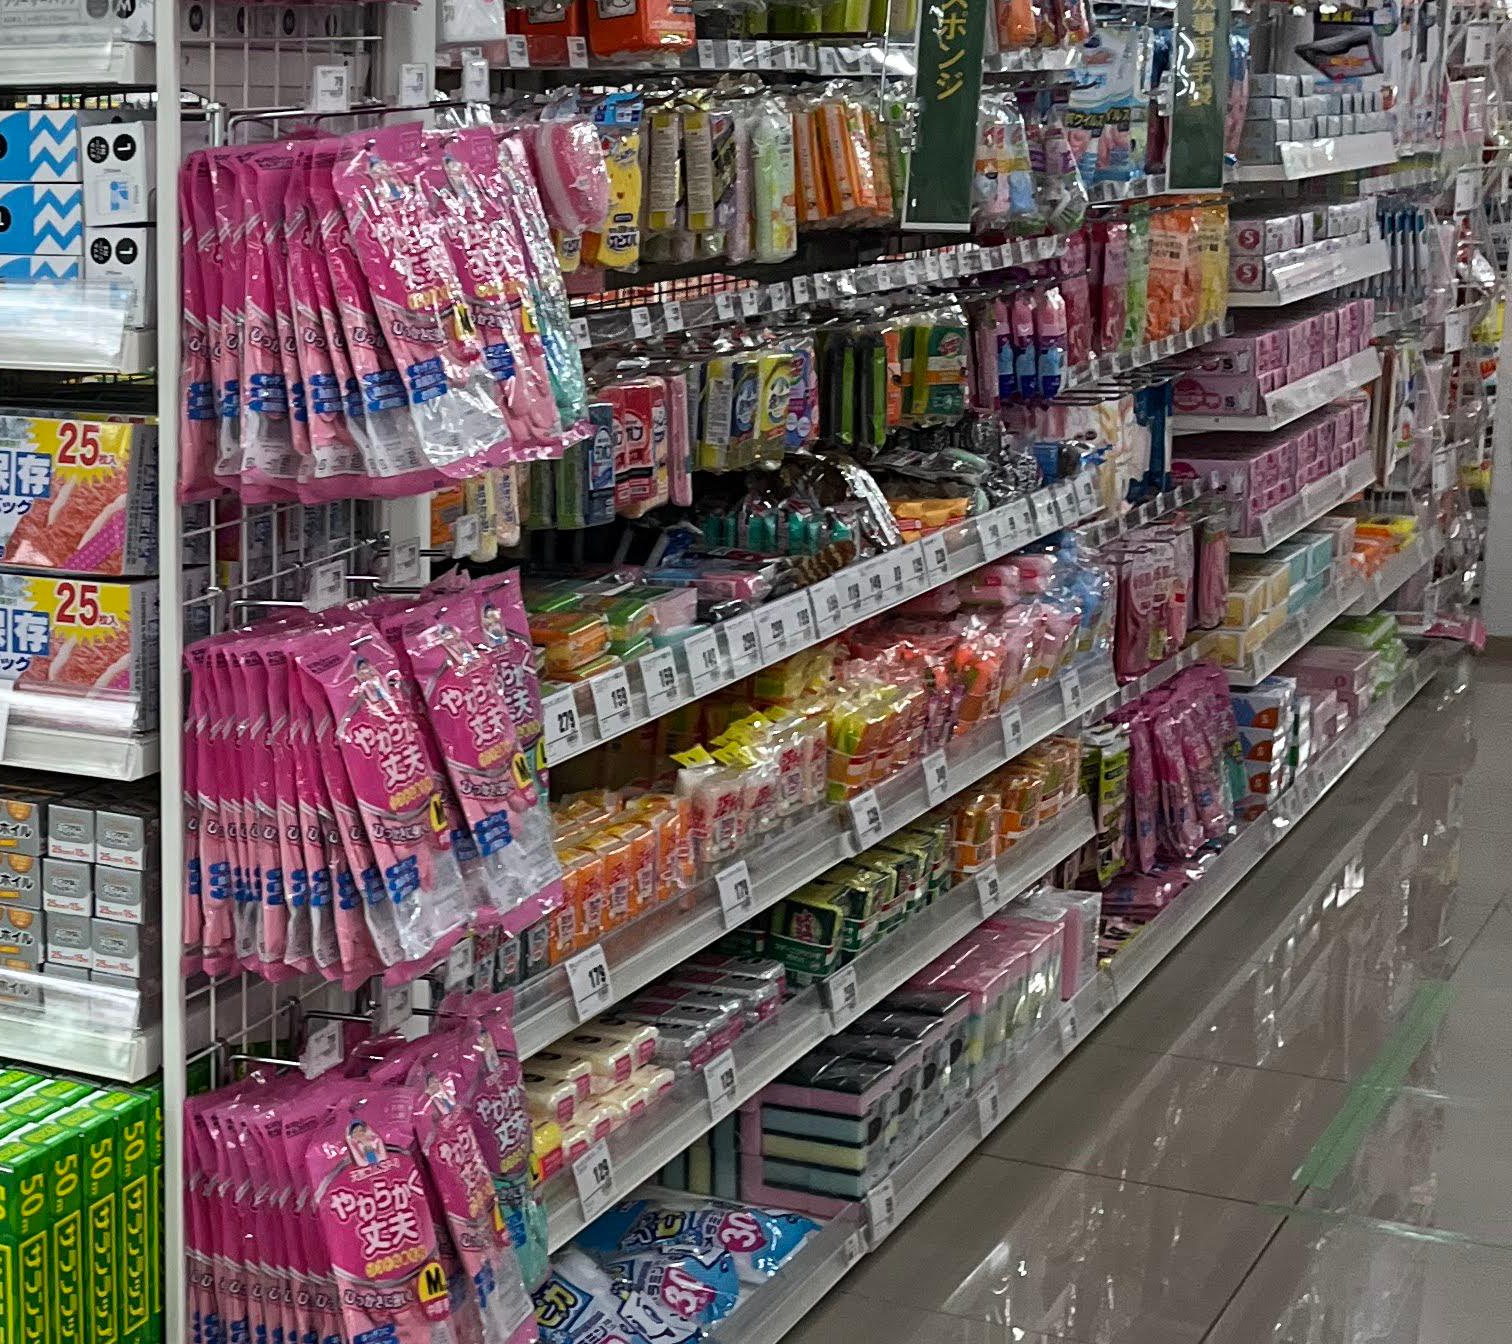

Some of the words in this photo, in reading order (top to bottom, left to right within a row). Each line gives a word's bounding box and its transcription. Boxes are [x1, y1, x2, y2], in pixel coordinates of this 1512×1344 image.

[331, 1169, 425, 1221] やわらかく
[360, 1211, 420, 1256] 丈夫
[721, 1213, 758, 1250] 30
[666, 1267, 706, 1314] 30
